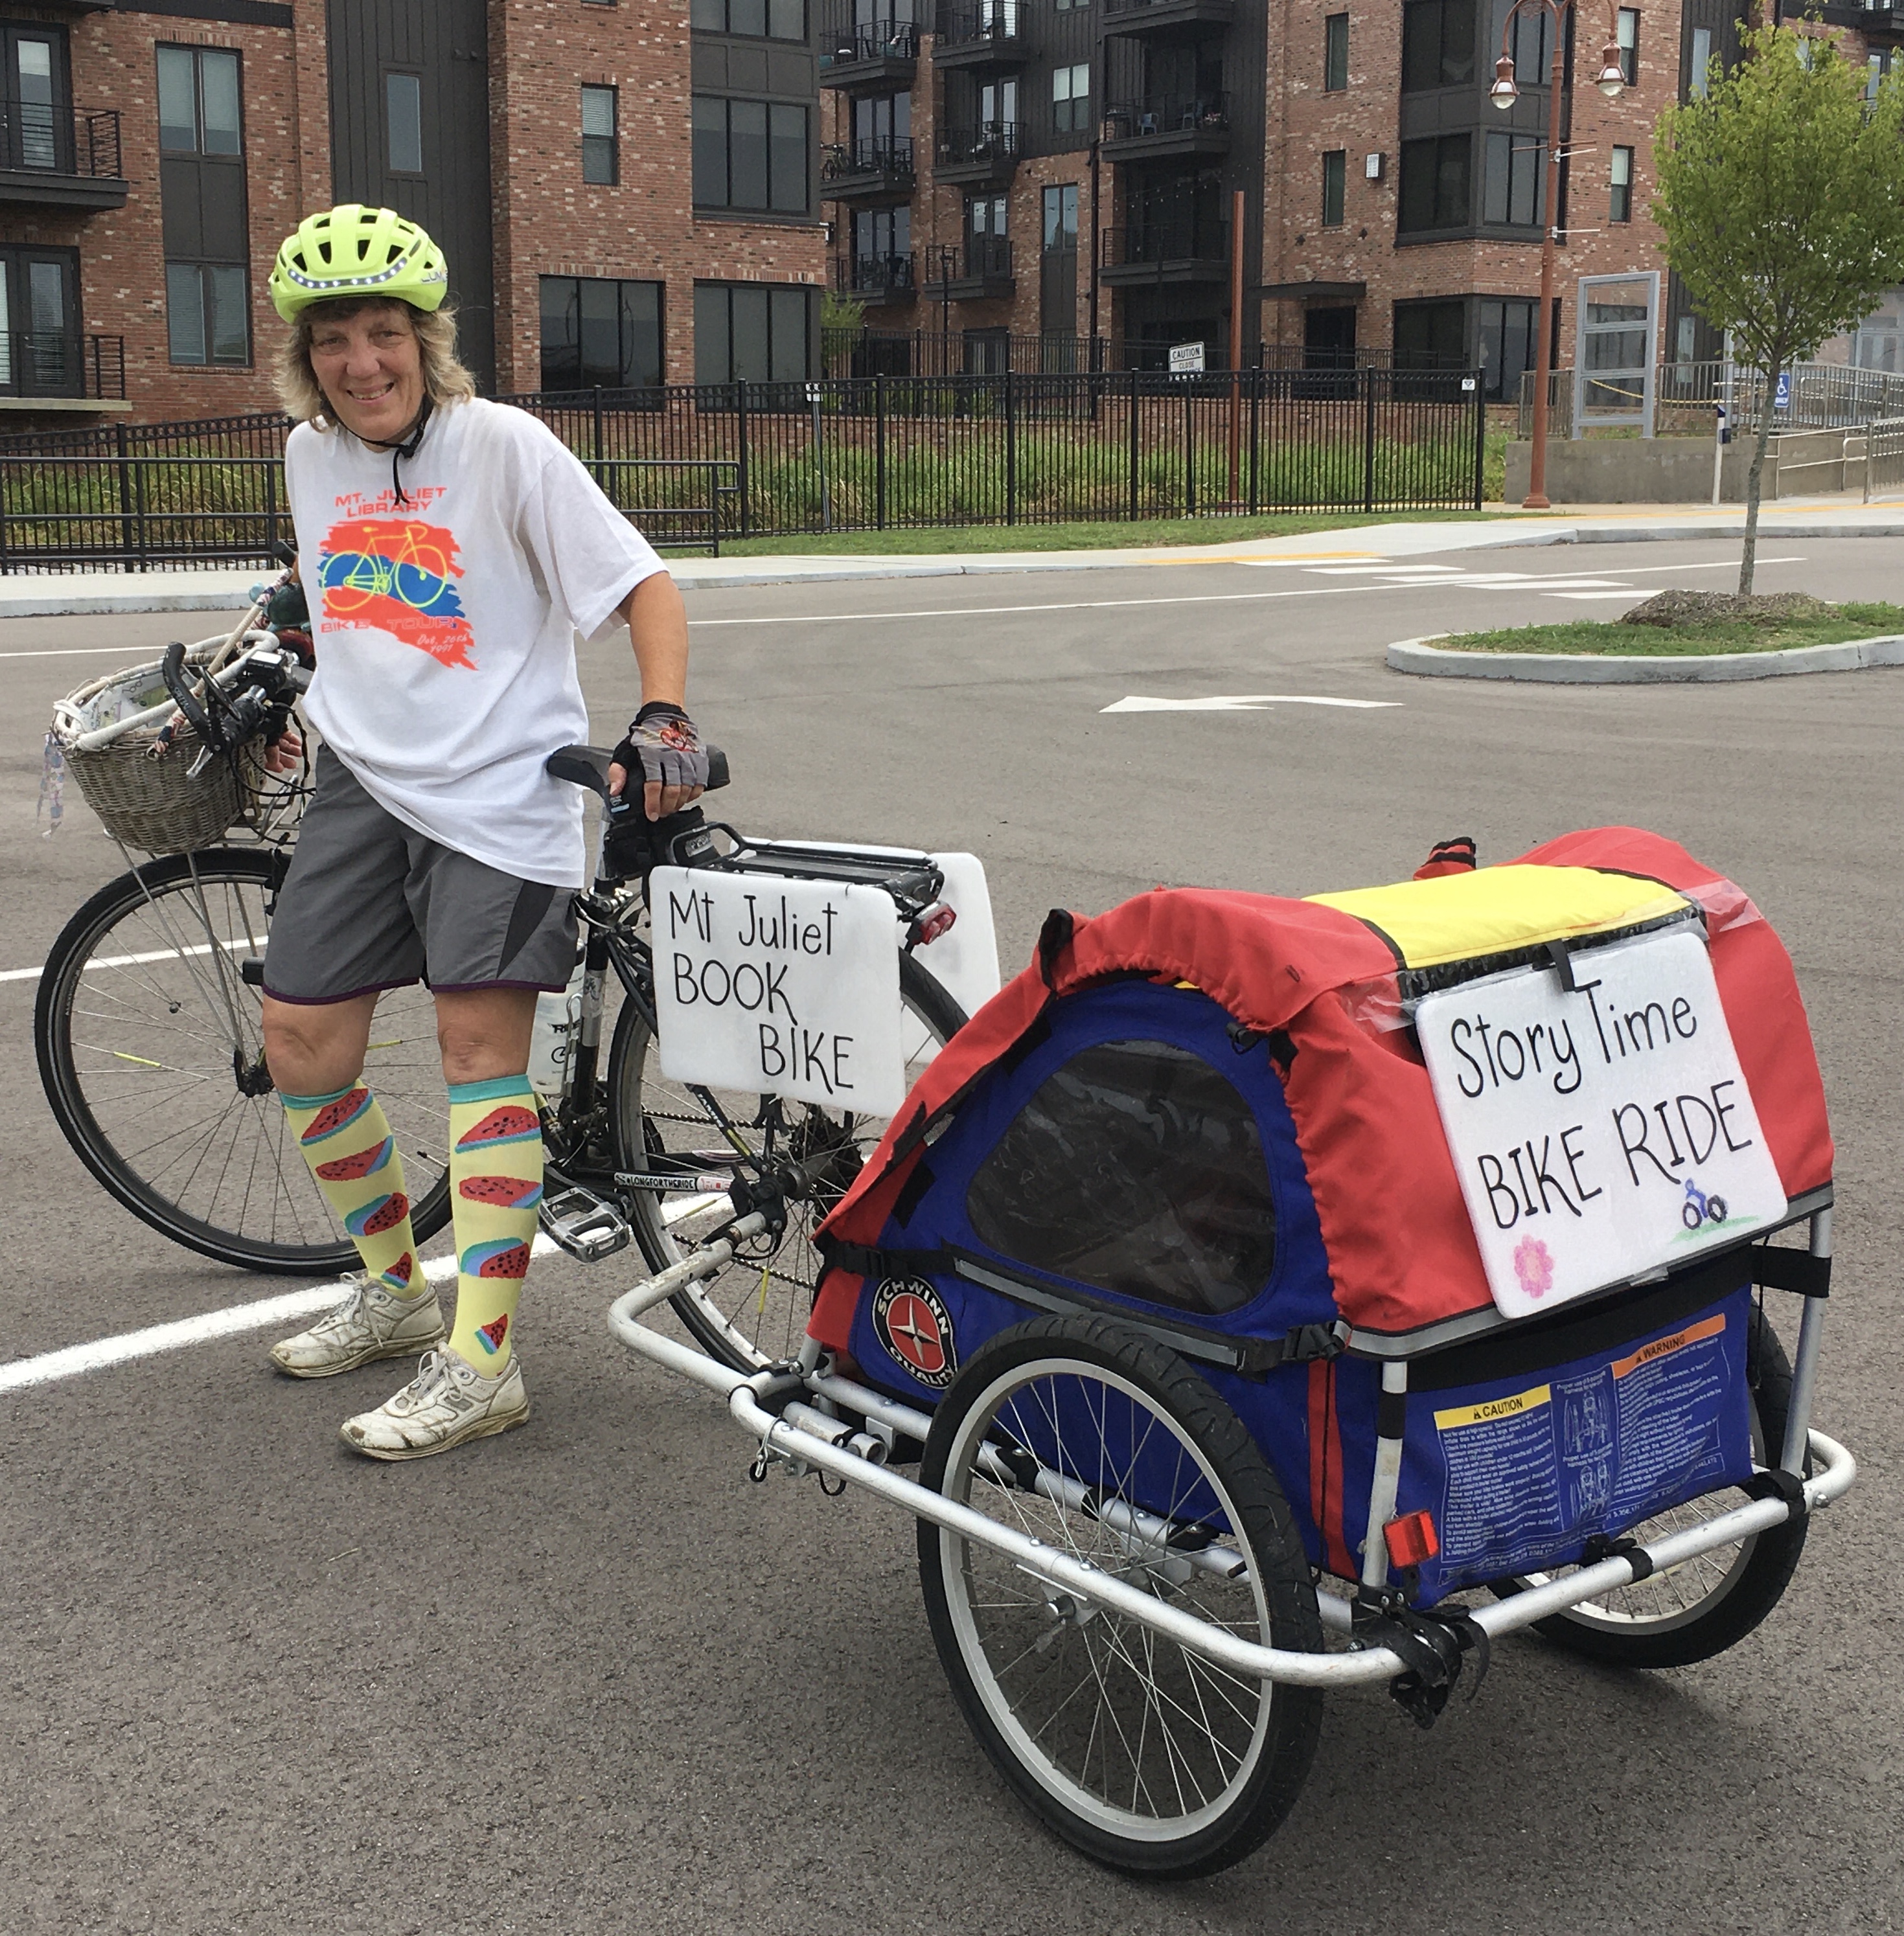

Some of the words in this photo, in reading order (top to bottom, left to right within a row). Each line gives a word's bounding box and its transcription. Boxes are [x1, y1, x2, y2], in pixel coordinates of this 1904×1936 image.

[1173, 347, 1200, 360] CAUTION
[335, 492, 366, 507] MT.
[377, 487, 447, 501] JULIET
[347, 501, 432, 518] LIBRARY
[321, 619, 372, 633] BIKE
[669, 889, 715, 943] Mt
[739, 895, 838, 955] Juliet
[674, 953, 798, 1027] BOOK
[1451, 1014, 1582, 1099] Story
[1572, 979, 1697, 1064] Time
[759, 1023, 854, 1095] BIKE
[1477, 1125, 1602, 1229] BIKE
[1612, 1080, 1752, 1187] RIDE
[877, 1281, 949, 1335] SCHWINN
[1642, 1334, 1685, 1359] WARNING
[889, 1347, 955, 1385] QUALITY
[1482, 1397, 1523, 1417] CAUTION
